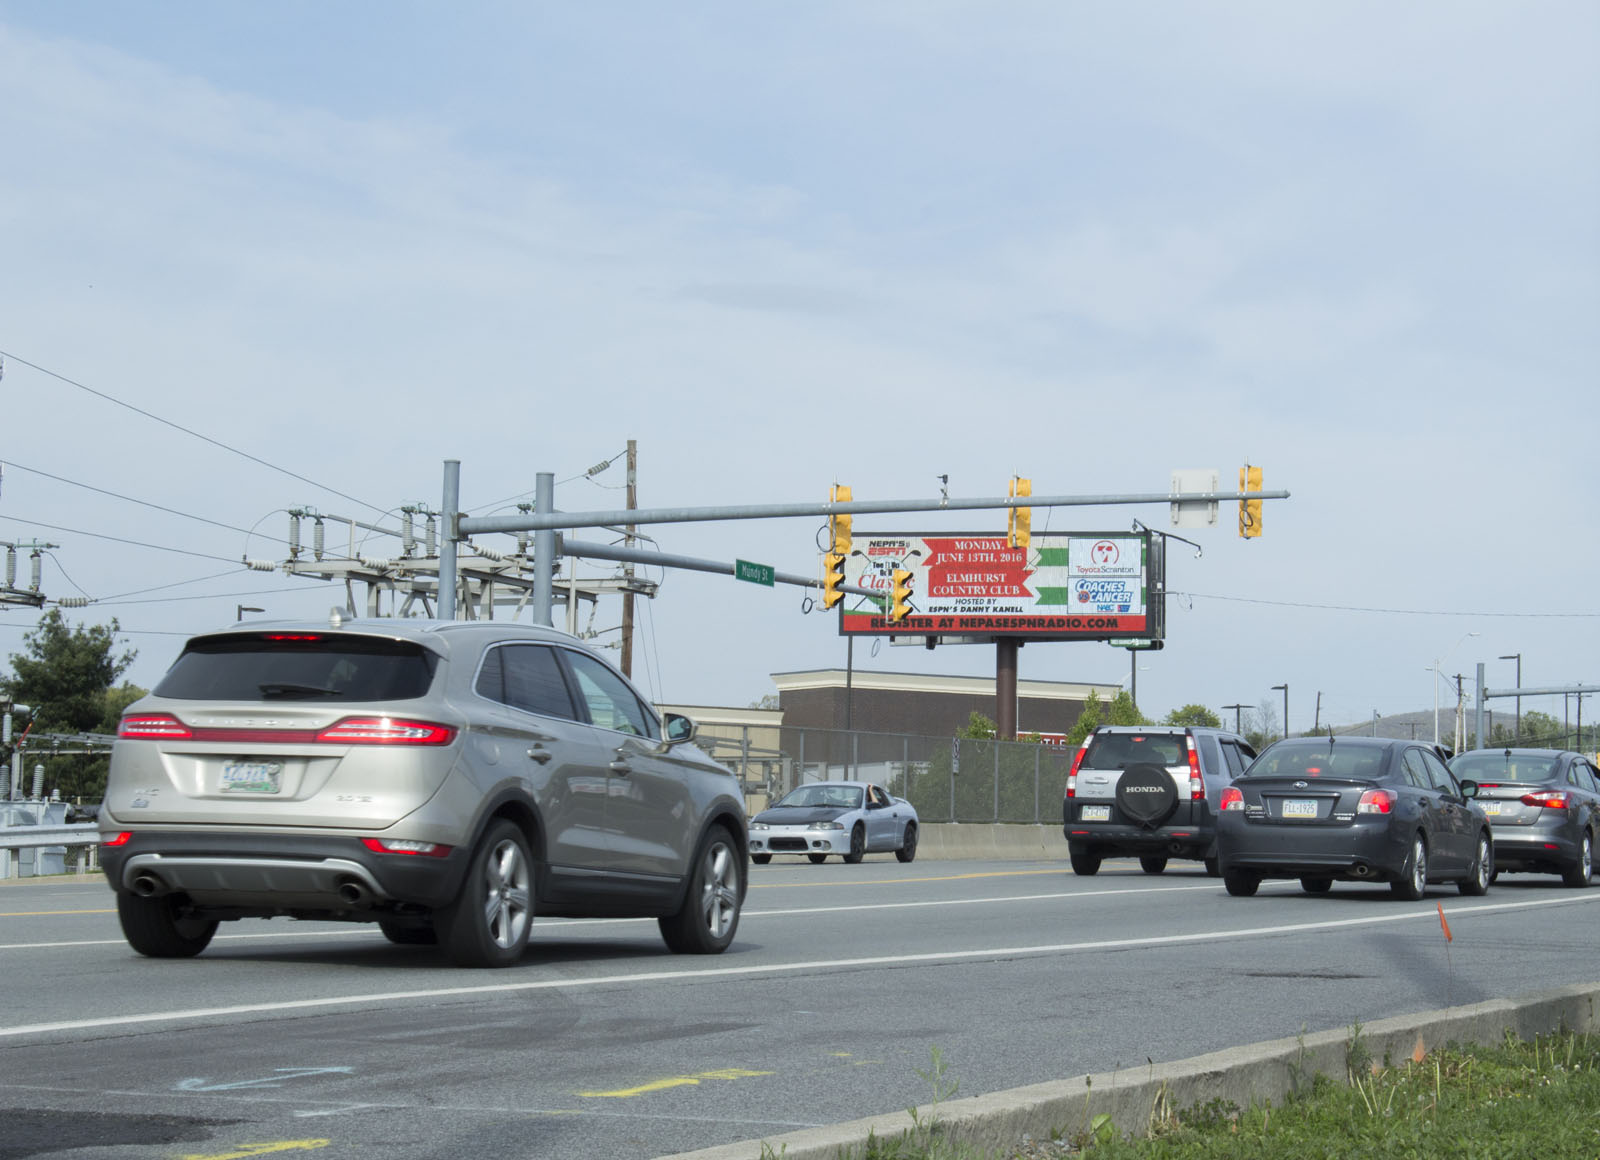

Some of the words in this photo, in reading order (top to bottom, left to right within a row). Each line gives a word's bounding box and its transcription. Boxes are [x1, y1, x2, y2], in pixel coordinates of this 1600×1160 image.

[954, 541, 1005, 551] MONDAY,
[868, 547, 906, 556] ESPN
[936, 553, 965, 565] JUNE
[1000, 553, 1023, 562] 2016
[742, 564, 761, 581] Mundy
[762, 568, 768, 581] St
[857, 574, 916, 590] Clasc
[946, 573, 1007, 583] ELMHURST
[933, 586, 988, 595] COUNTRY
[990, 586, 1020, 595] CLUB
[1075, 579, 1126, 592] COACHES
[1089, 592, 1133, 603] CANCER
[938, 618, 955, 628] AT
[959, 618, 1119, 628] NEPASESPNRADIO.COM
